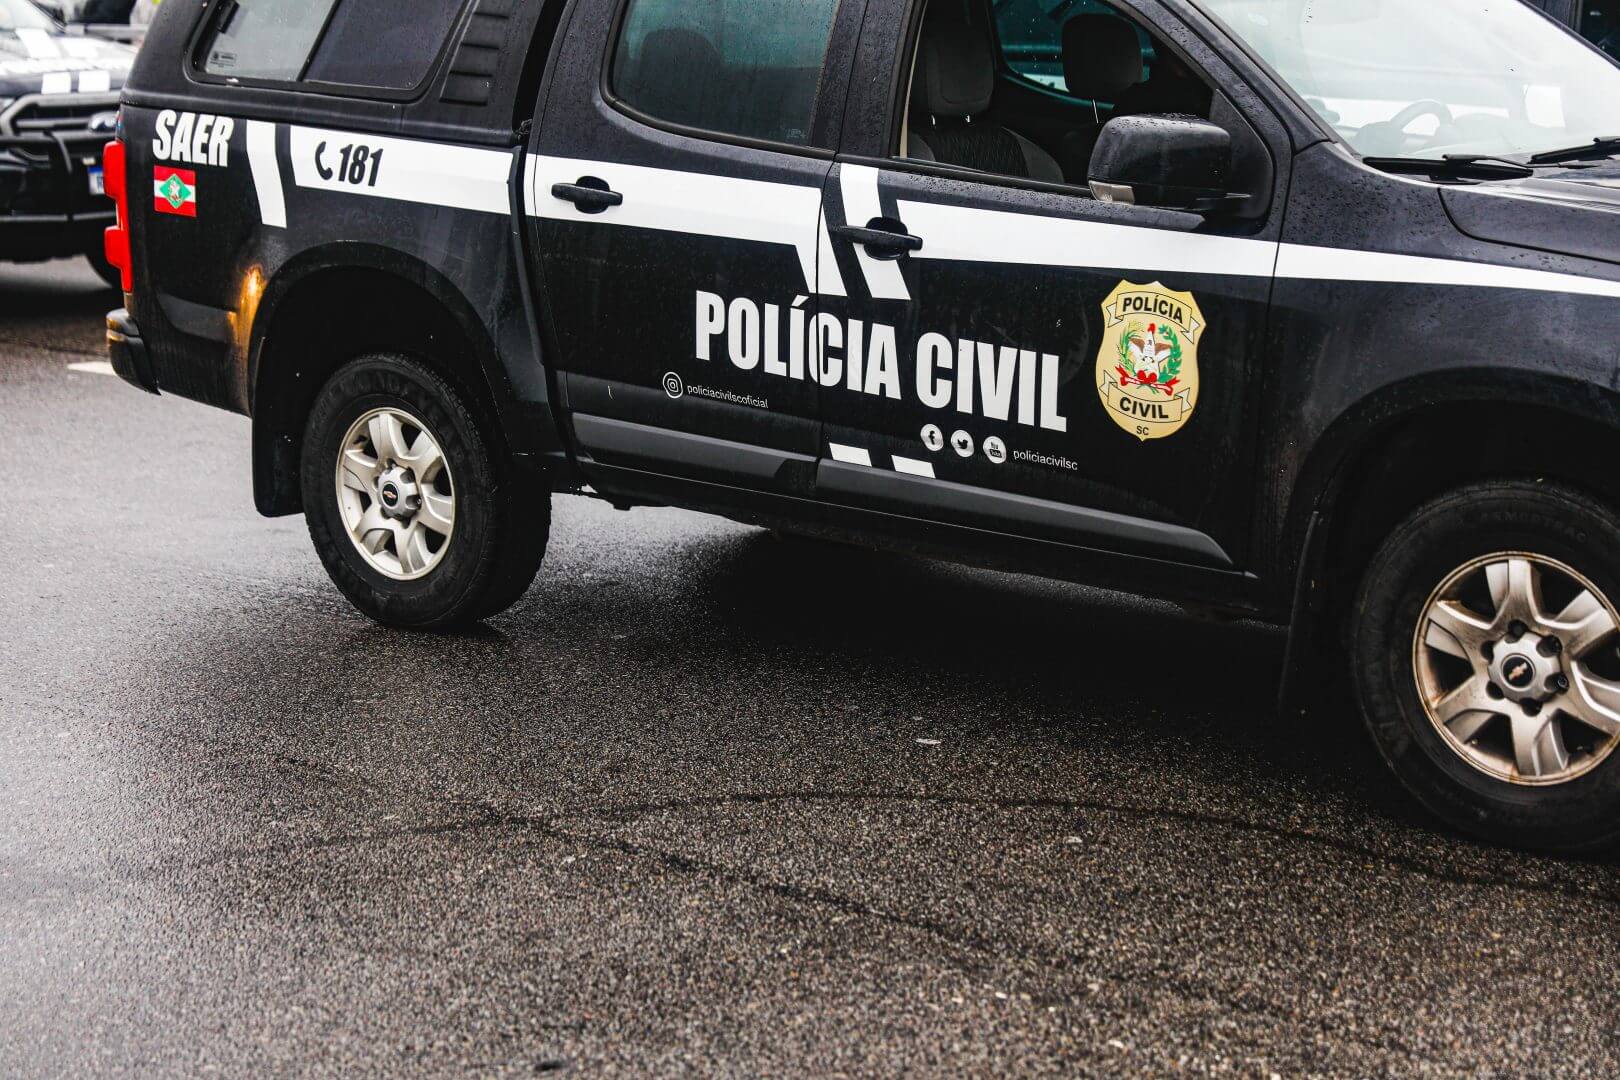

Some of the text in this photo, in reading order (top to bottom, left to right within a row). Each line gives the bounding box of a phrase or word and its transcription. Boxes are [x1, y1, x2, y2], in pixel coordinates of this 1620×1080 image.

[153, 109, 234, 168] SAER
[339, 144, 384, 187] 181
[1122, 295, 1183, 323] POLÍCIA
[695, 290, 1067, 433] POLÍCIA CIVIL
[687, 385, 769, 408] policiacivilscoficial
[1119, 397, 1169, 419] CIVIL
[1136, 425, 1149, 436] SC
[1013, 450, 1078, 471] policiacivilsc
